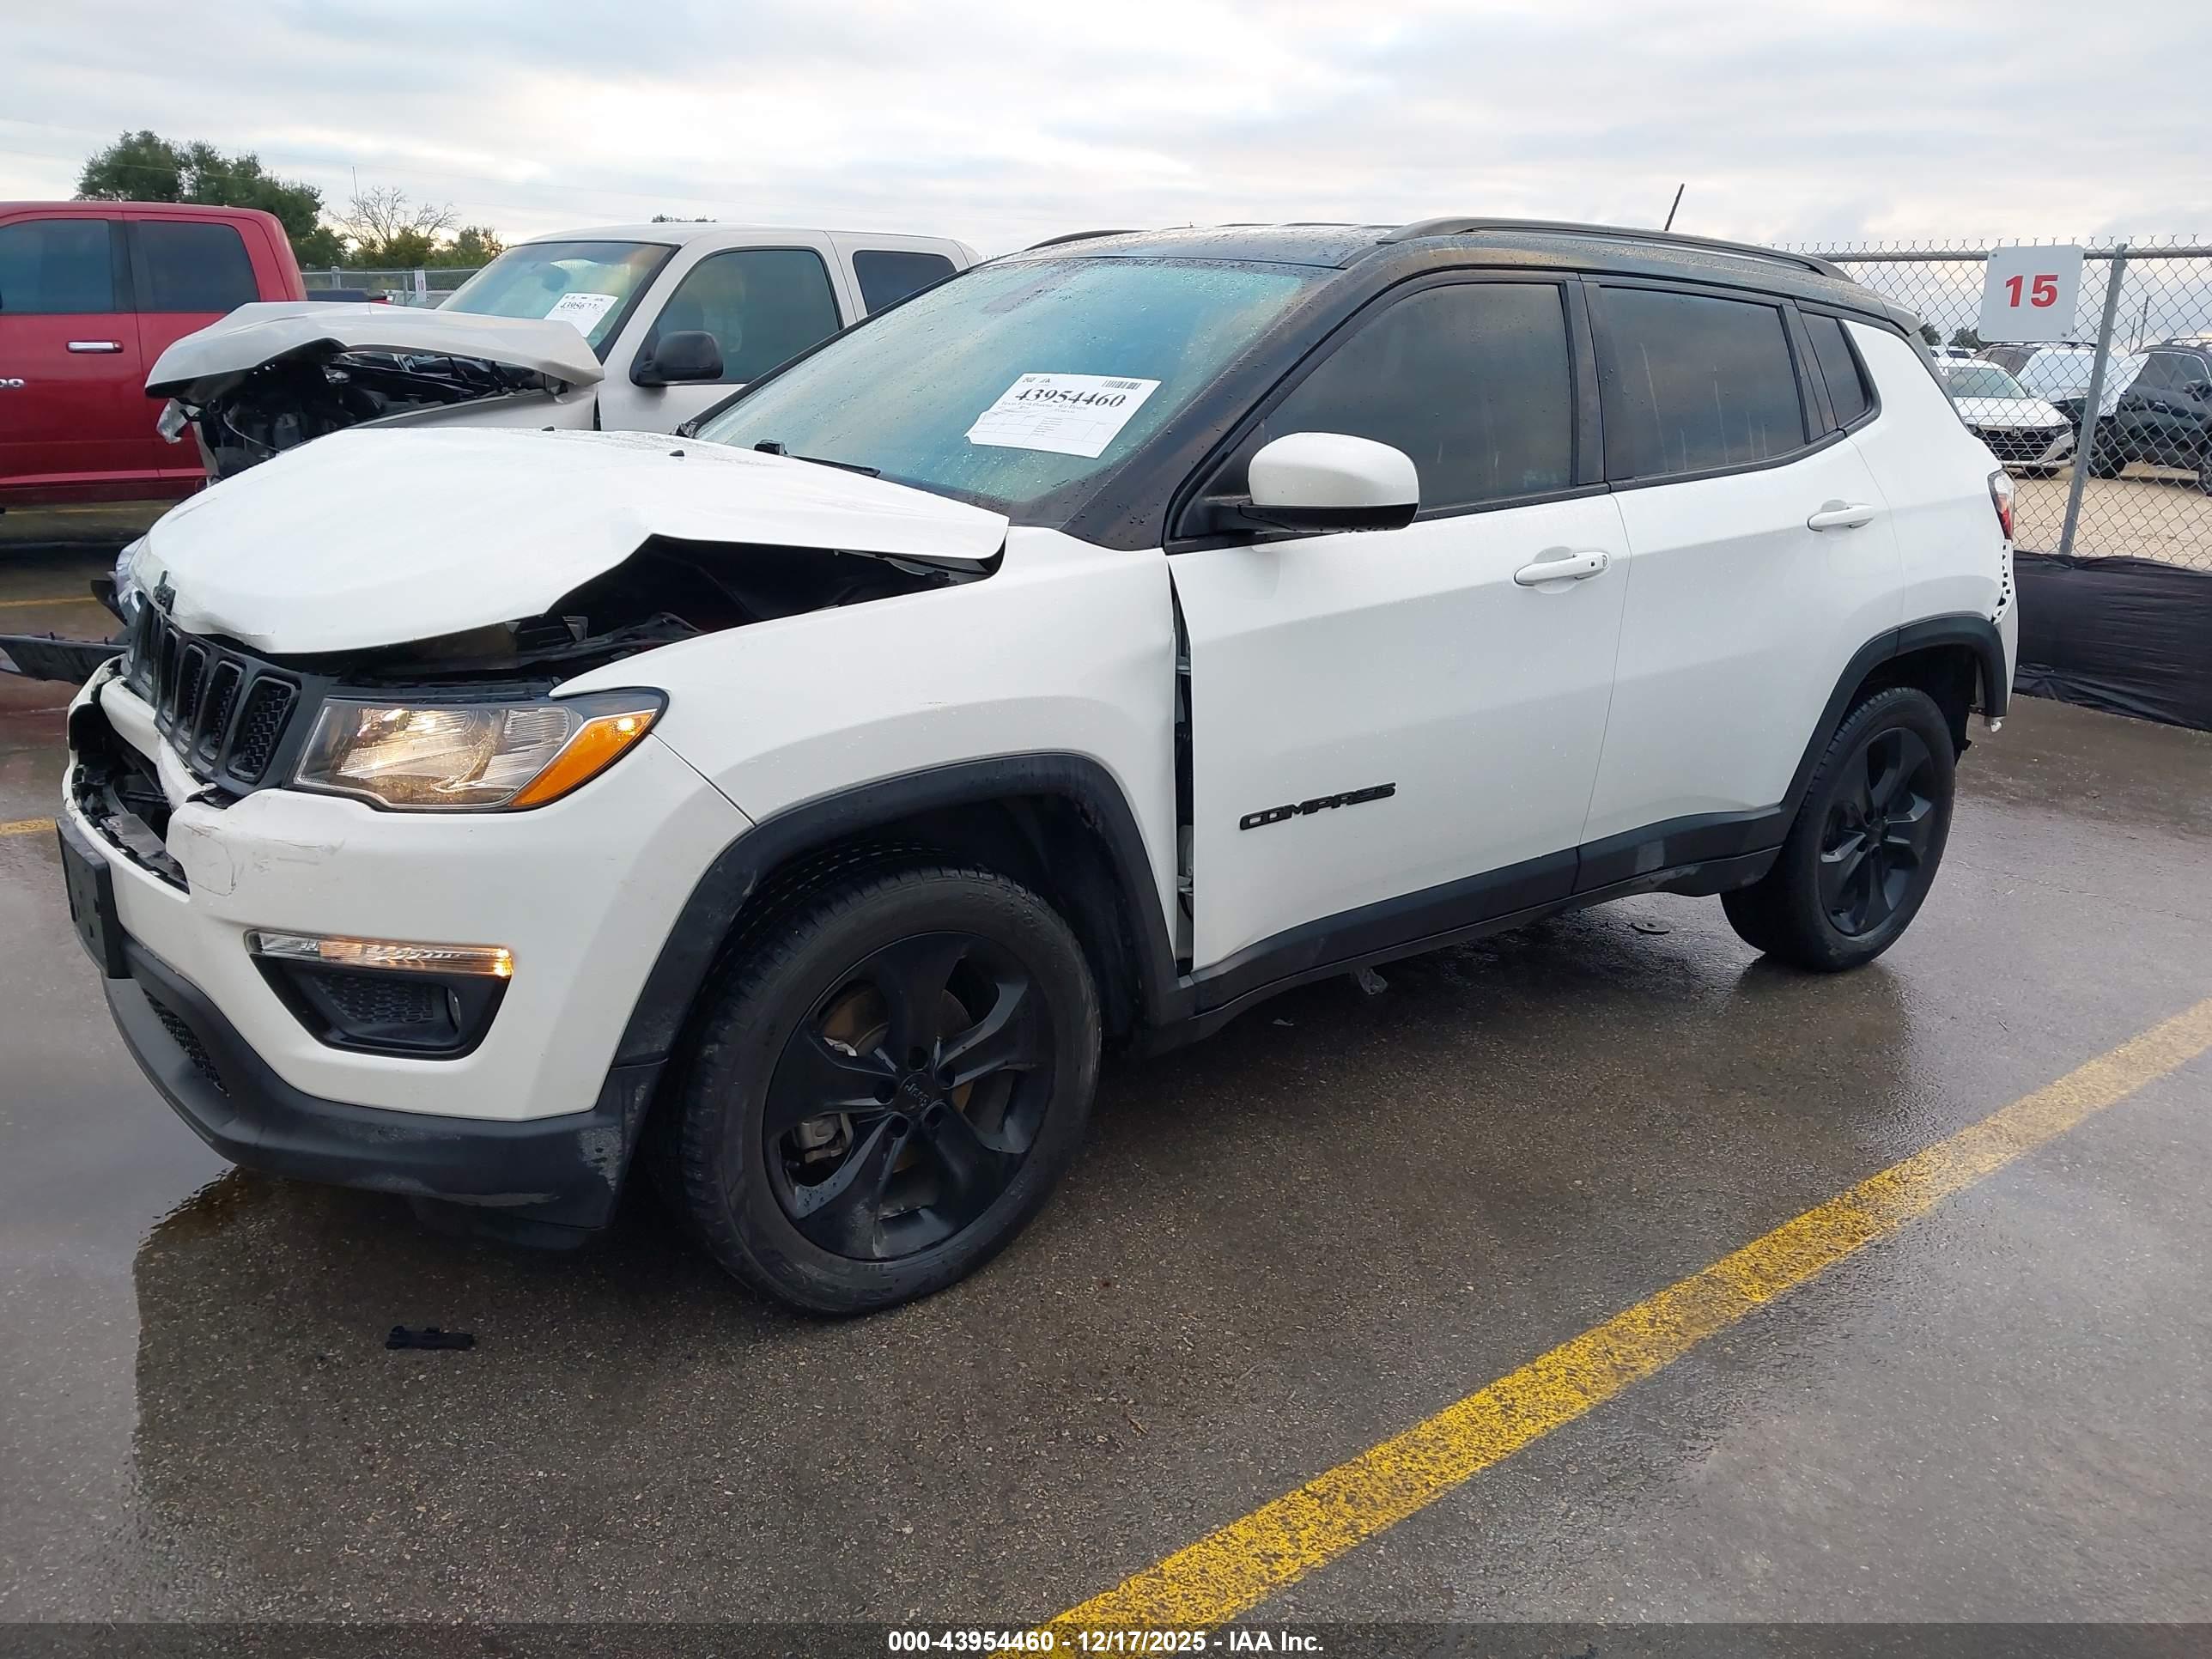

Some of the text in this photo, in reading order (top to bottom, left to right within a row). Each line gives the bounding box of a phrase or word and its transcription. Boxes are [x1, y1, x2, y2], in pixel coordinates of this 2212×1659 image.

[417, 280, 424, 291] 10
[2005, 274, 2058, 307] 15
[1015, 388, 1127, 408] 43954460
[1240, 782, 1396, 830] COMPASS
